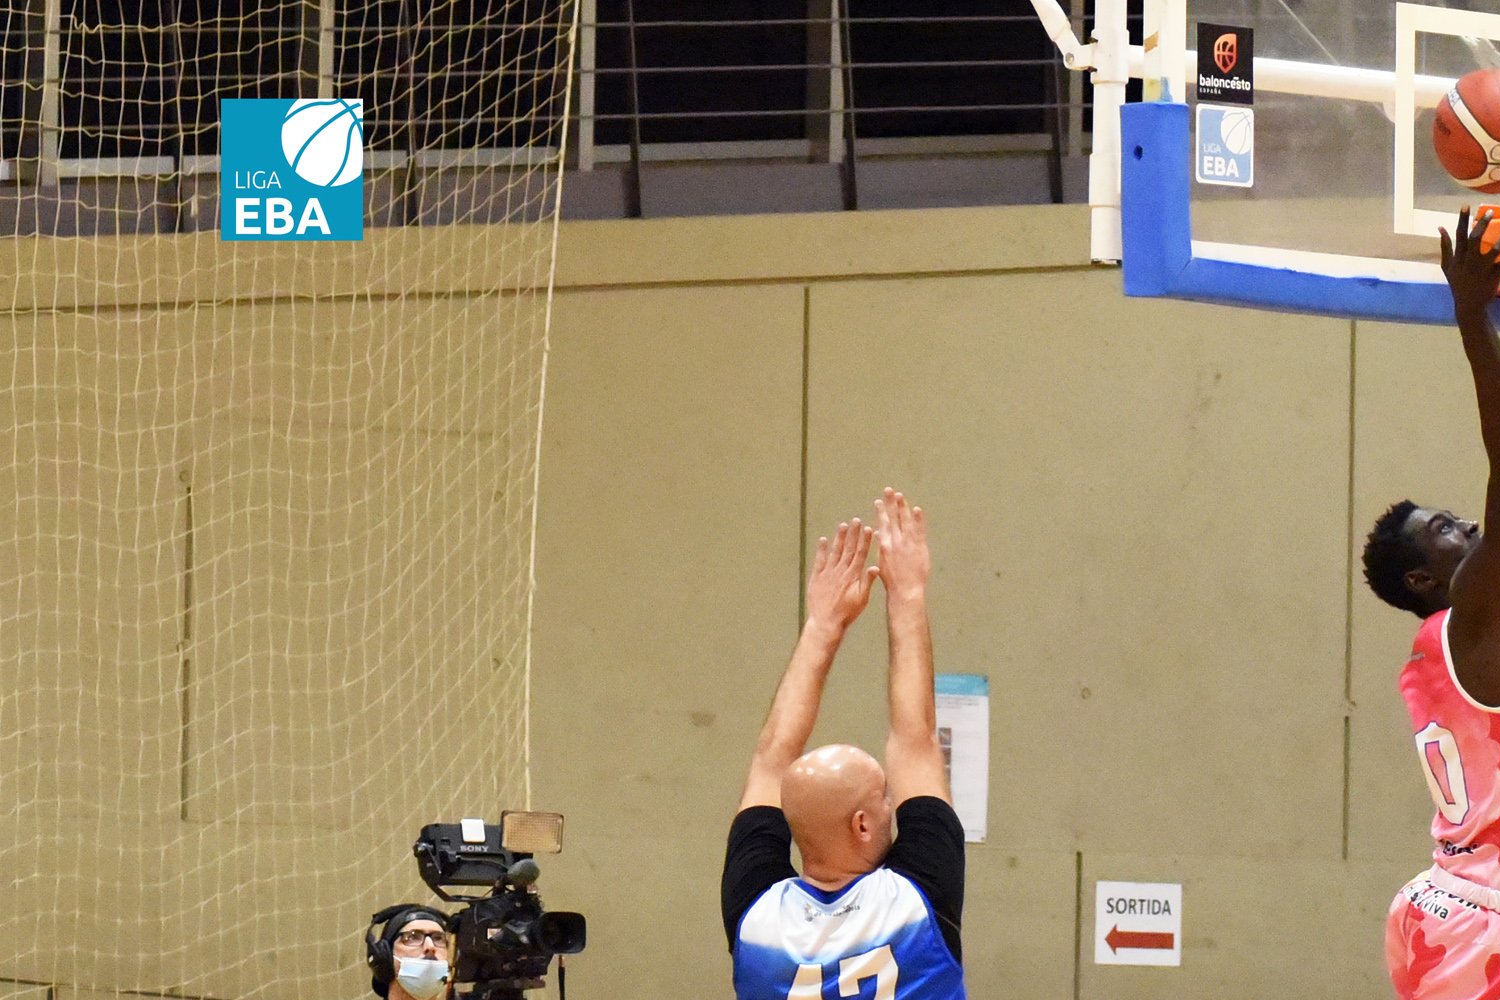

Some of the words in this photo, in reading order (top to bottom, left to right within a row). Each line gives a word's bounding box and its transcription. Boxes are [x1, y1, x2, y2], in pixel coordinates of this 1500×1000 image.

[1203, 143, 1222, 154] LIGA
[1203, 155, 1240, 178] EBA
[1106, 897, 1172, 916] SORTIDA
